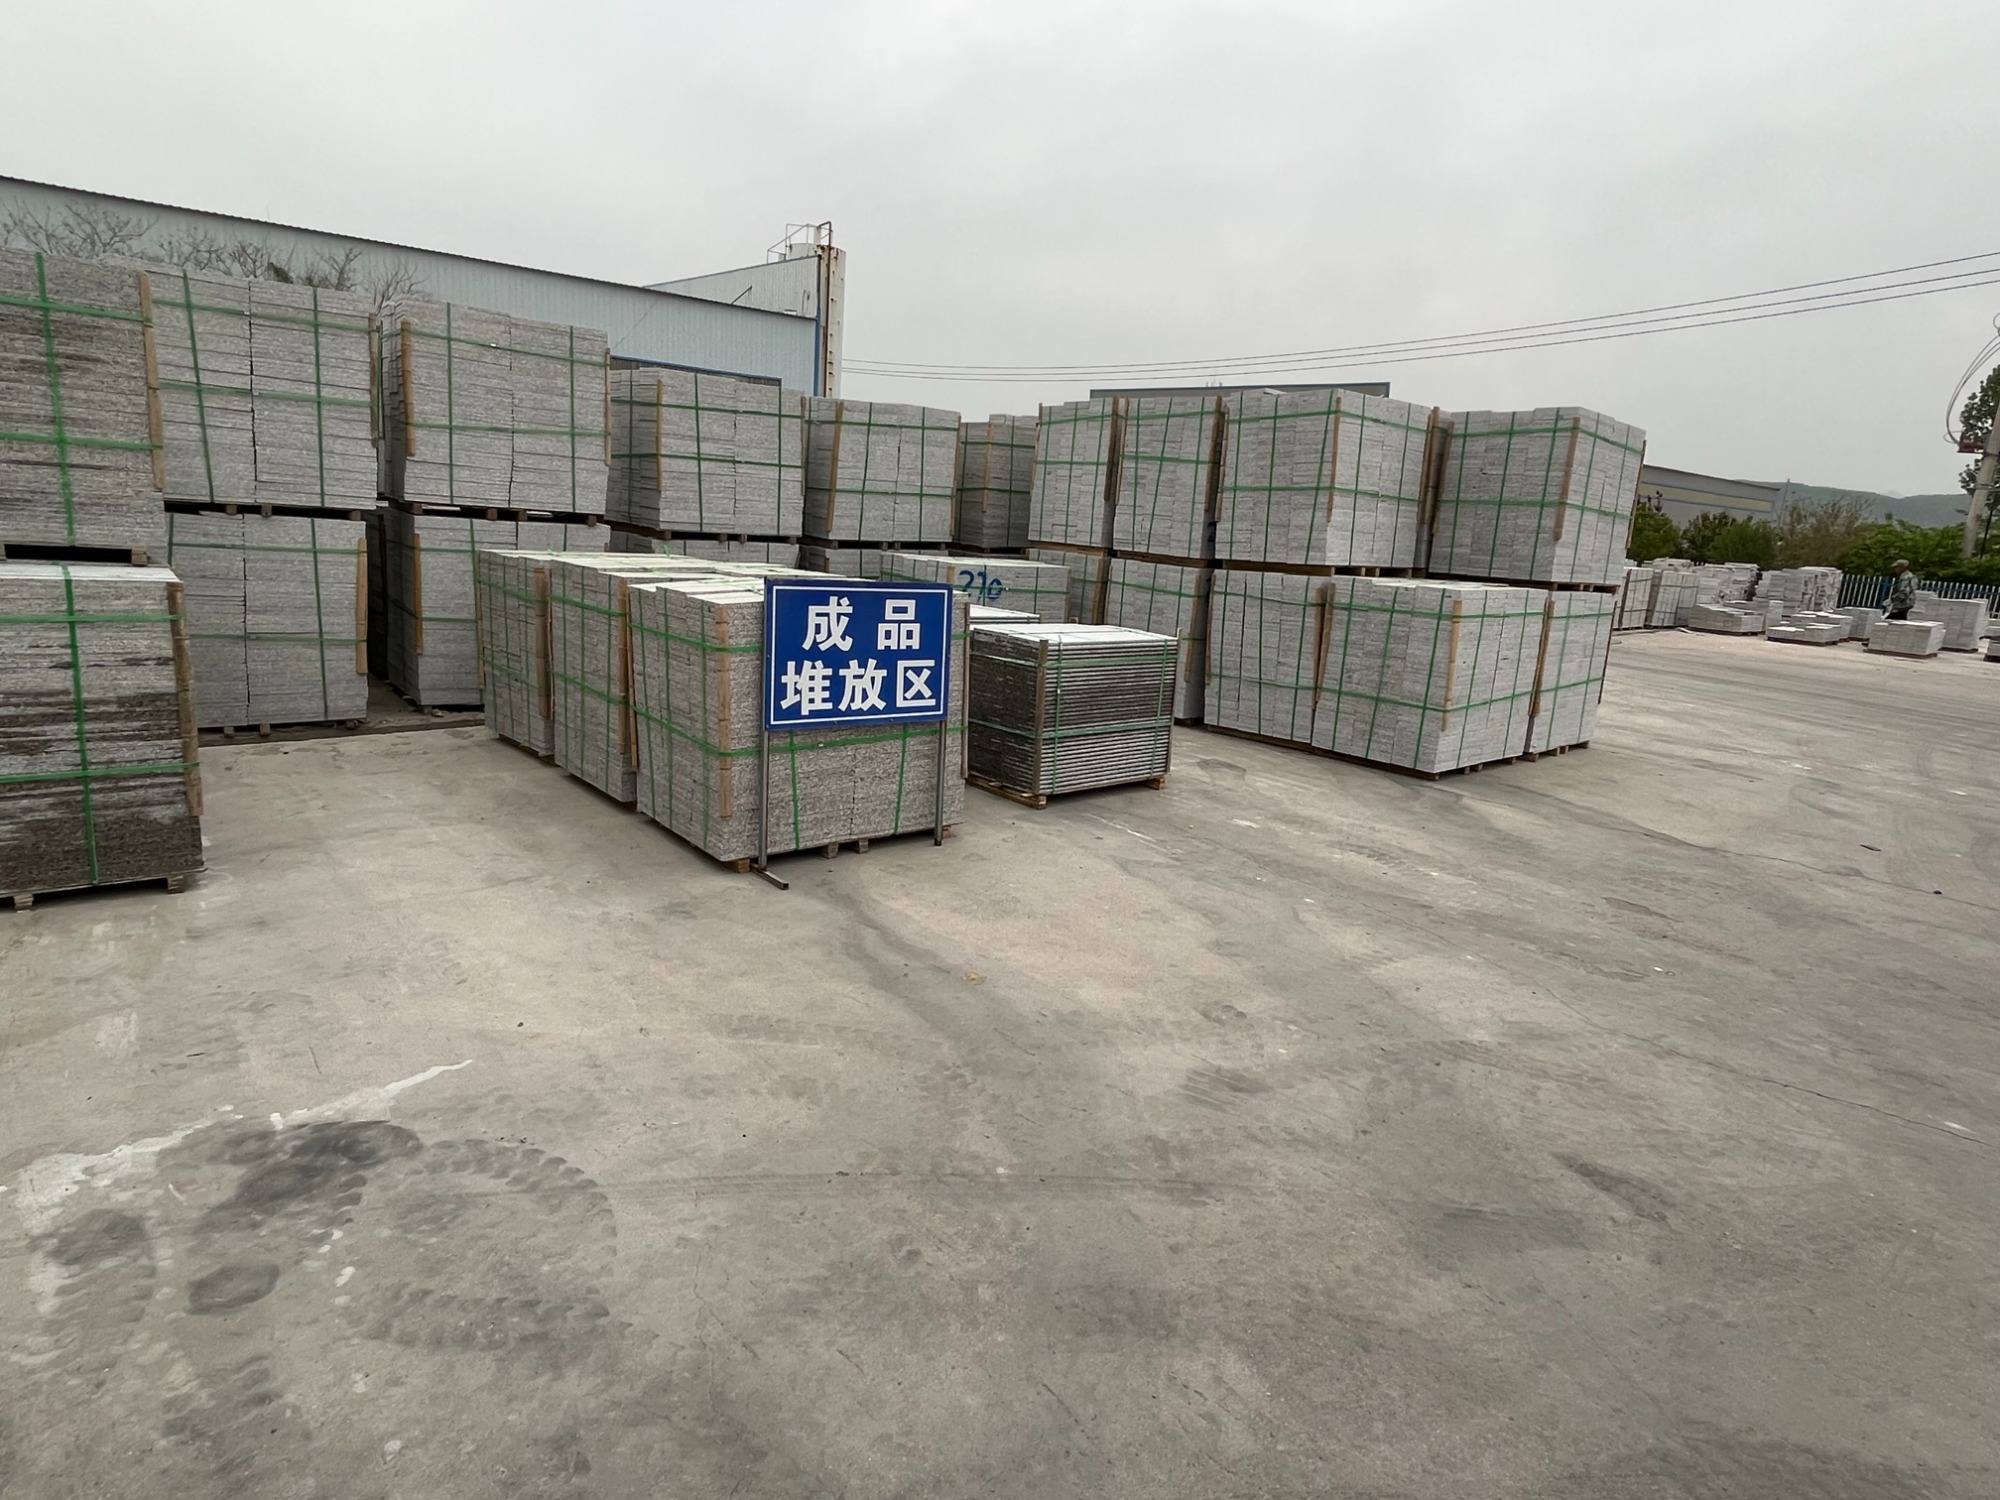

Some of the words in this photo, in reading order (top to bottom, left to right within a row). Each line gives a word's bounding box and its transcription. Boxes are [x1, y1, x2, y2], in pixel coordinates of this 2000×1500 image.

[802, 596, 921, 651] 成品
[780, 658, 936, 715] 堆放区
